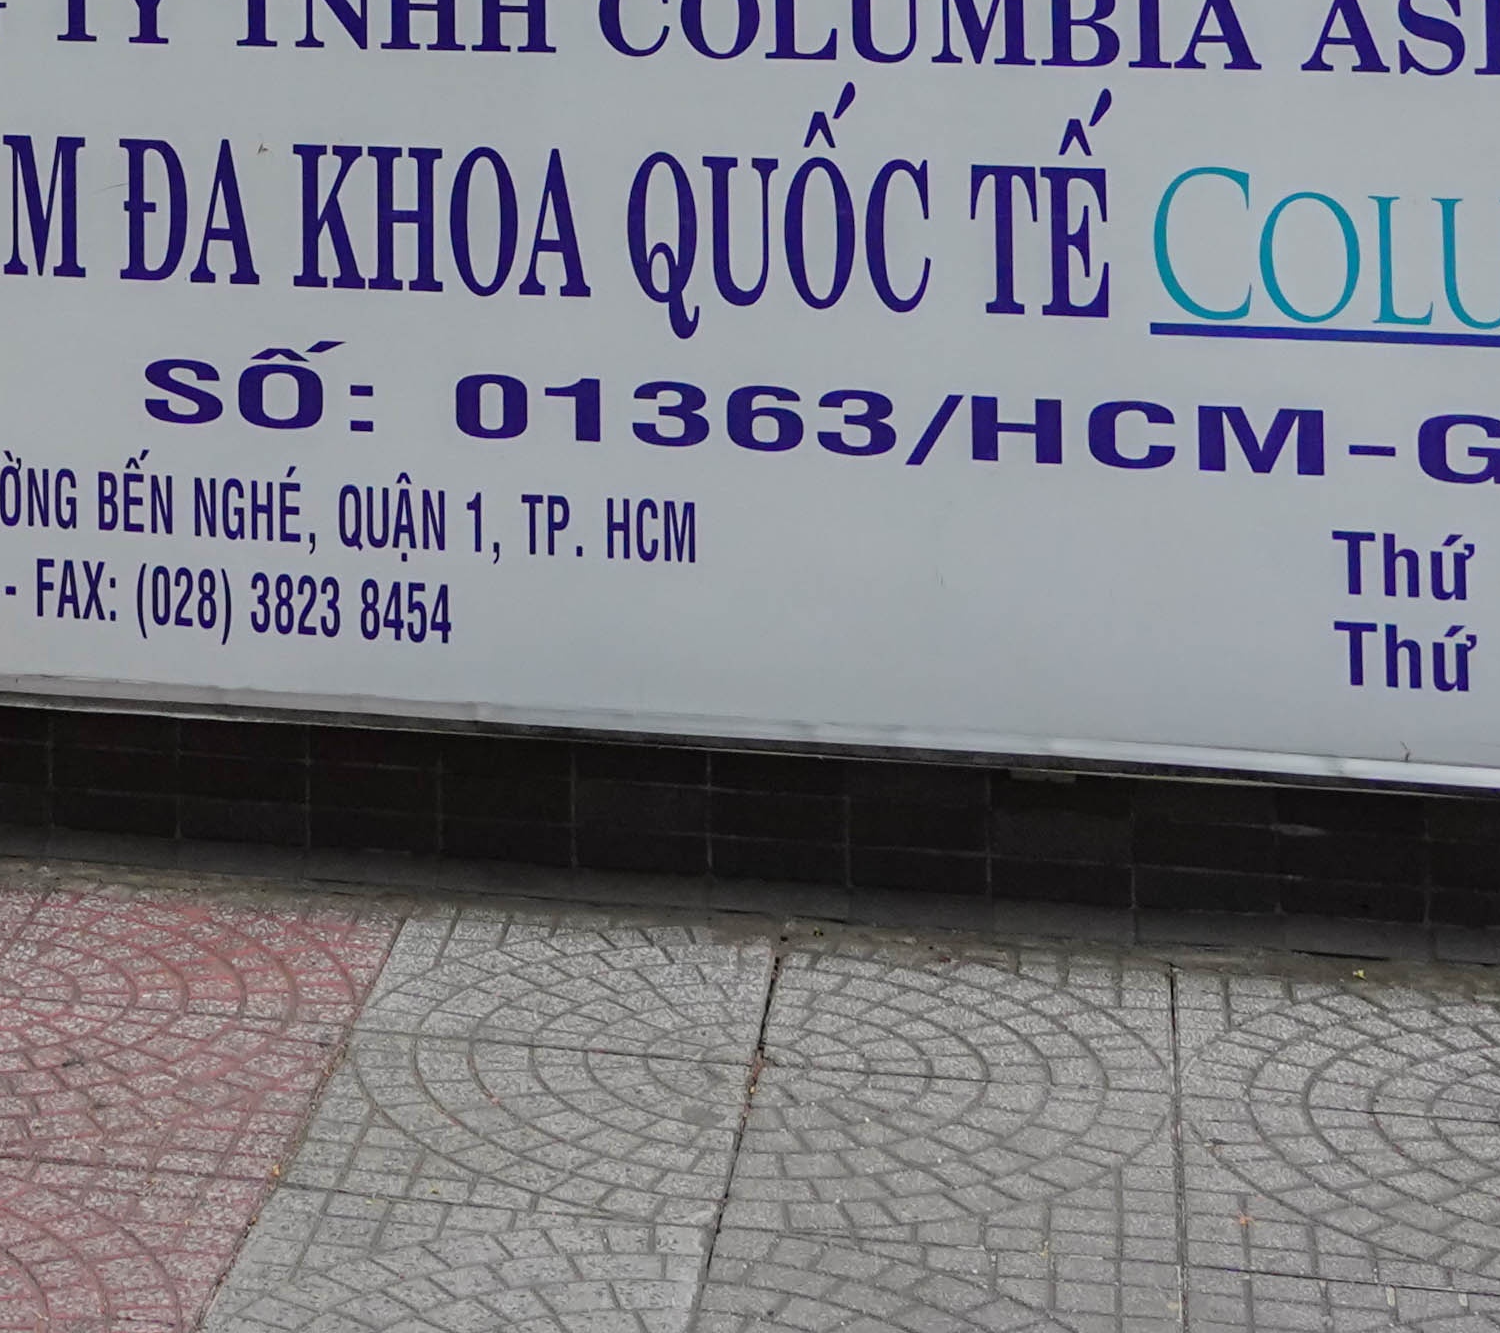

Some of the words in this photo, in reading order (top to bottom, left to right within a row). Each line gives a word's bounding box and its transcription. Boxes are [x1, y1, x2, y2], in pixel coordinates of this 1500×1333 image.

[119, 138, 260, 286] ĐA
[292, 143, 591, 298] KHOA
[627, 81, 932, 340] QUỐC
[970, 88, 1112, 319] TẾ
[144, 340, 374, 433] SỐ:
[97, 449, 173, 535] BẾN
[194, 465, 316, 555] NGHÉ,
[338, 472, 446, 563] QUẬN
[466, 492, 500, 565] 1,
[521, 493, 583, 558] TP.
[606, 497, 696, 564] HCM
[36, 558, 117, 622] FAX:
[136, 562, 232, 646] (028)
[250, 571, 341, 638] 3823
[360, 578, 452, 644] 8454
[1331, 530, 1475, 601] Thứ
[1333, 620, 1478, 692] Thứ
